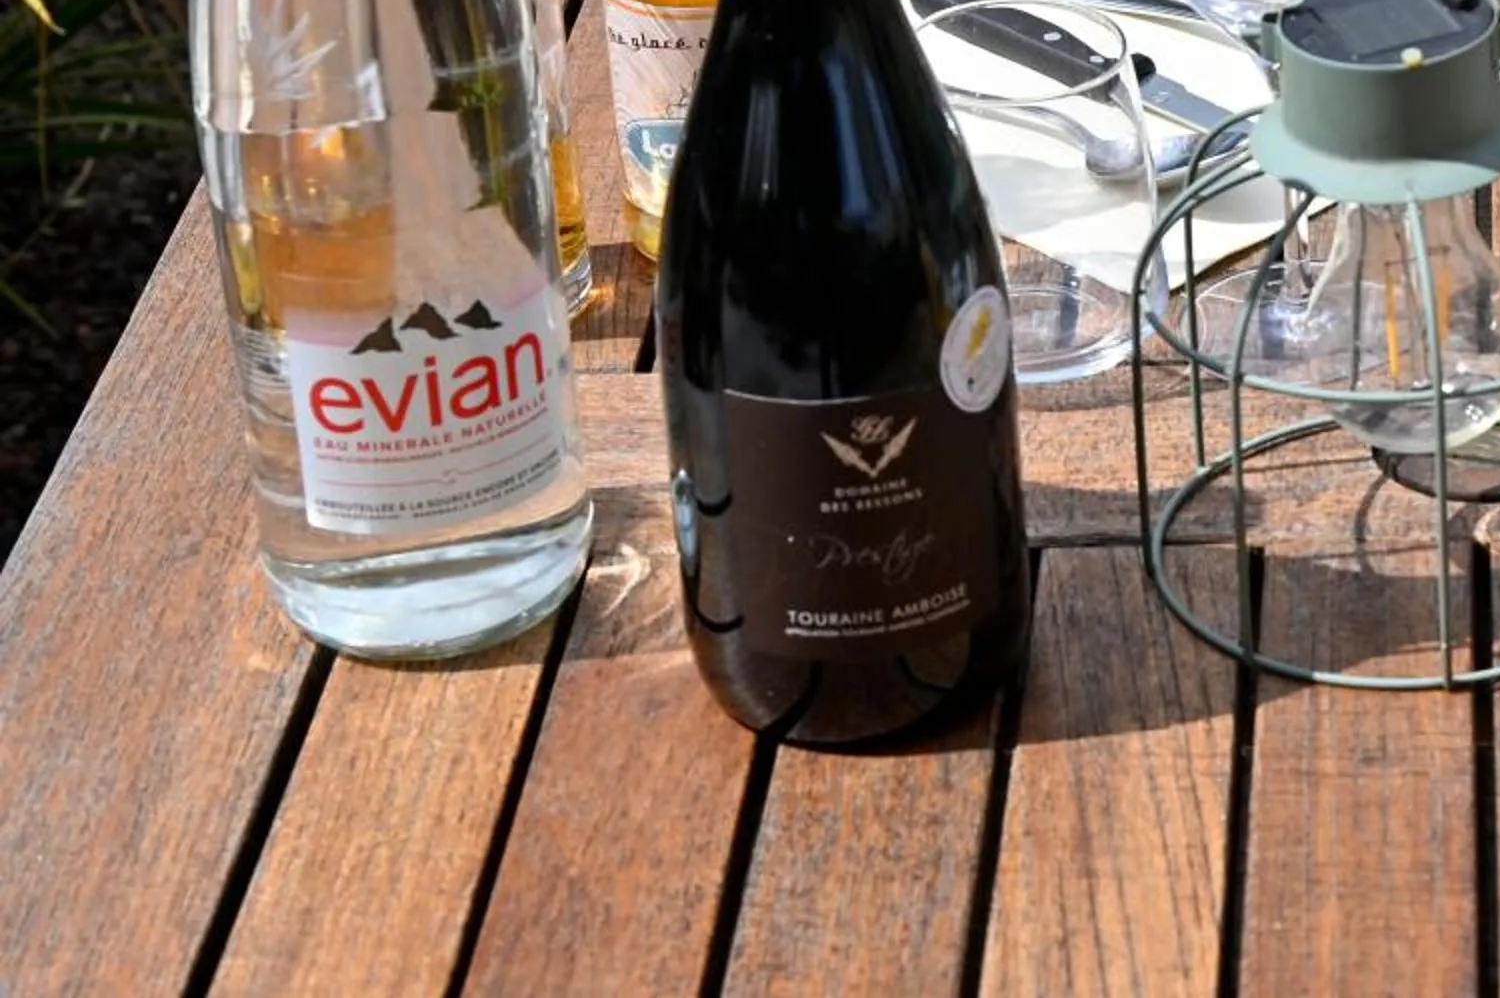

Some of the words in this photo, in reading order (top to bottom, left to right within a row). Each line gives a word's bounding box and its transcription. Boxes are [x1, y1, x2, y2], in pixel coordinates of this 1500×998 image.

[309, 332, 544, 434] evian
[313, 436, 348, 452] EAU
[460, 391, 547, 438] NATURELLE
[786, 608, 884, 627] TOURAINE
[892, 582, 968, 619] AMBOISE
